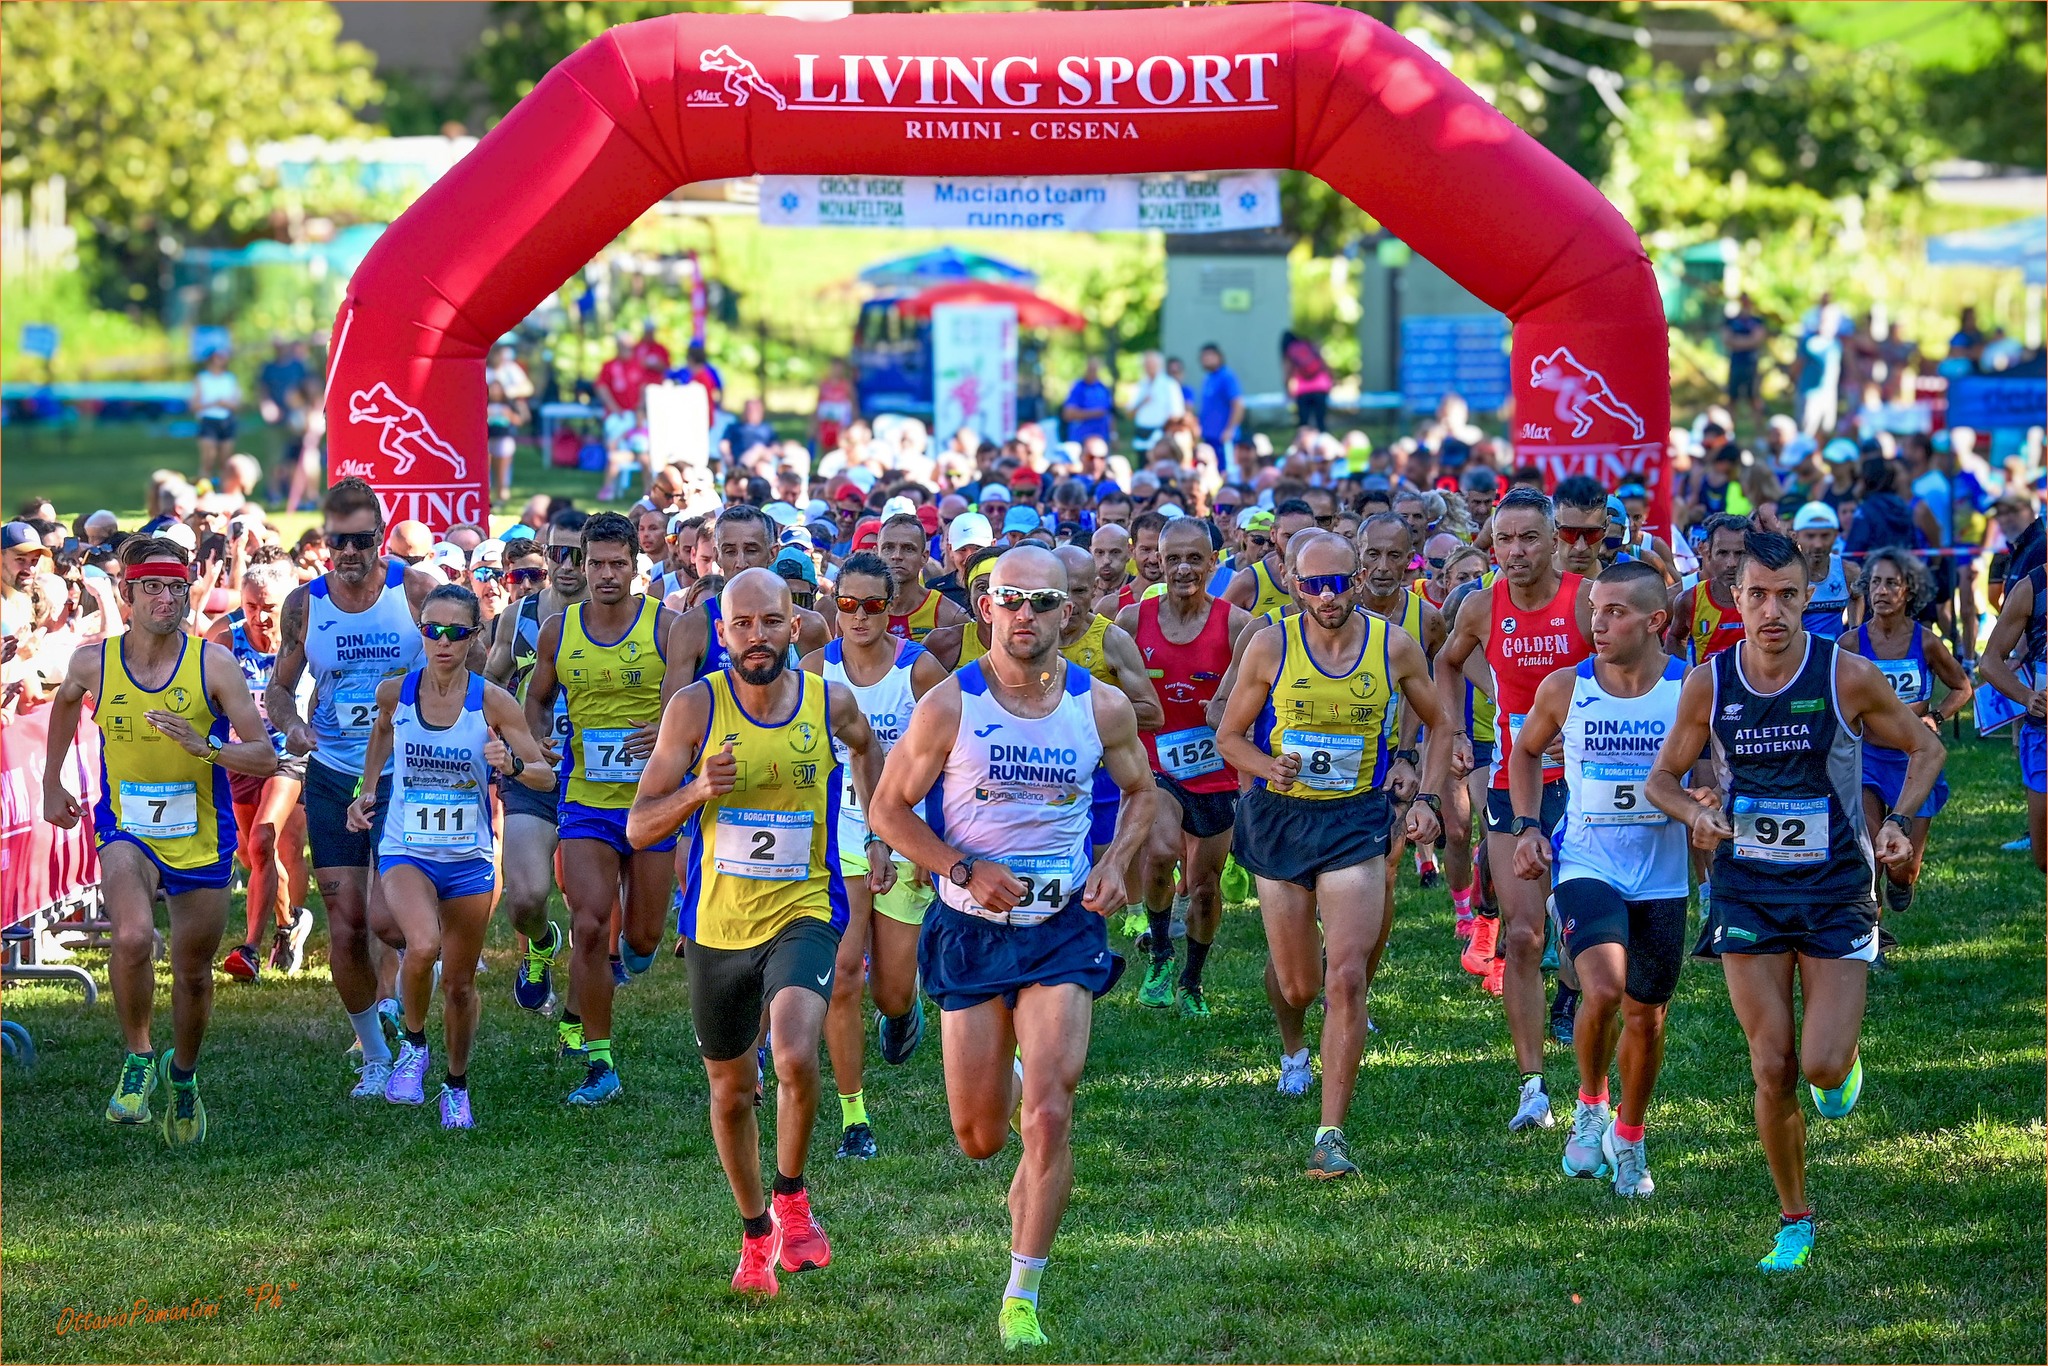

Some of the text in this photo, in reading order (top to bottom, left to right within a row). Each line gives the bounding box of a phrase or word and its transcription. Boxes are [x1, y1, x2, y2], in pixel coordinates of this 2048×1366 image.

[794, 52, 1279, 105] LIVING SPORT
[905, 120, 1003, 140] RIMINI
[1030, 121, 1140, 140] CESENA
[866, 178, 904, 196] VERDE
[934, 183, 1106, 204] Maciano team
[818, 200, 904, 217] NOVAFELTRIA
[1138, 202, 1221, 219] NOVAFELTRIA
[968, 212, 1065, 227] runners
[335, 632, 401, 648] DINAMO
[1501, 633, 1570, 658] GOLDEN
[336, 646, 401, 661] RUNNING
[1517, 653, 1554, 666] rimini
[351, 705, 379, 727] 2
[1584, 720, 1666, 736] DINAMO
[1734, 723, 1810, 740] ATLETICA
[1304, 735, 1331, 743] BORGATE
[1331, 737, 1363, 746] MACIANESI
[1735, 739, 1812, 755] BIOTEKNA
[404, 742, 473, 761] DINAMO
[597, 745, 634, 767] 74
[989, 744, 1078, 766] DINAMO
[1166, 738, 1216, 768] 152
[405, 757, 472, 773] RUNNING
[1309, 750, 1332, 775] 8
[988, 765, 1077, 784] RUNNING
[1604, 768, 1633, 776] BORGATE
[989, 790, 1044, 801] RomagnaBanca
[1612, 784, 1637, 810] 5
[148, 800, 167, 823] 7
[1758, 801, 1789, 810] BORGATE
[1790, 801, 1827, 811] MACIANESI
[416, 807, 464, 831] 111
[737, 812, 812, 824] 7 BORGATE MACIANESI
[1754, 816, 1806, 847] 92
[749, 830, 776, 861] 2
[1036, 858, 1071, 869] MACIANESI
